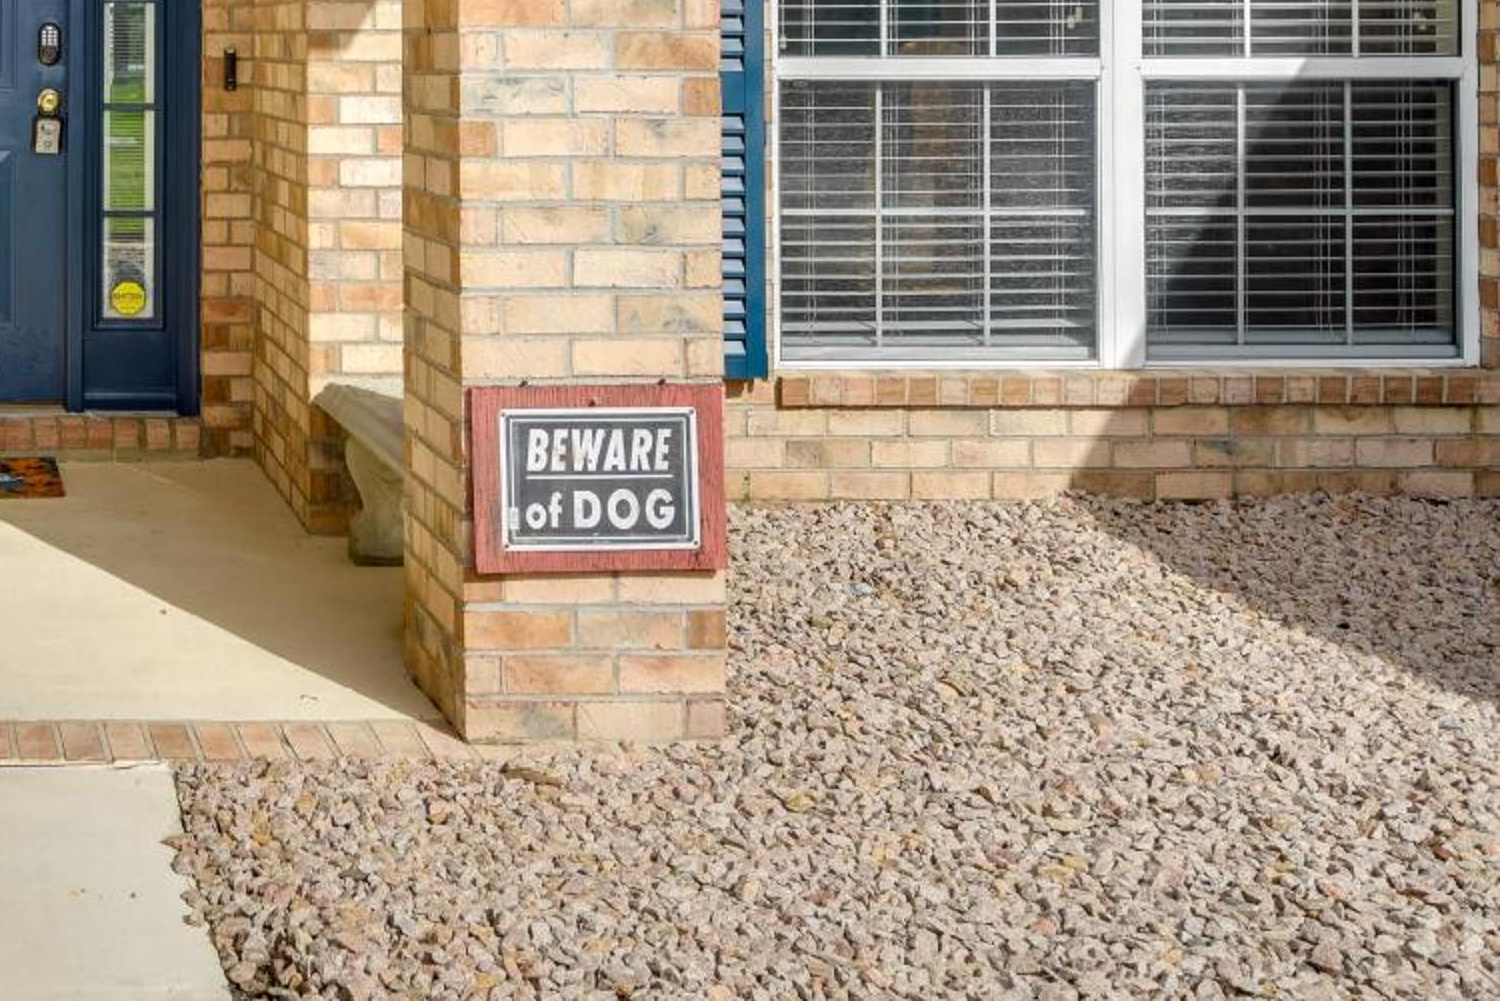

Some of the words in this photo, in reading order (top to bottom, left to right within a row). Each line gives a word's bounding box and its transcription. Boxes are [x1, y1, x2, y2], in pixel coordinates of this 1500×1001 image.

[526, 428, 672, 472] BEWARE
[525, 491, 563, 530] of
[573, 488, 676, 530] DOG
